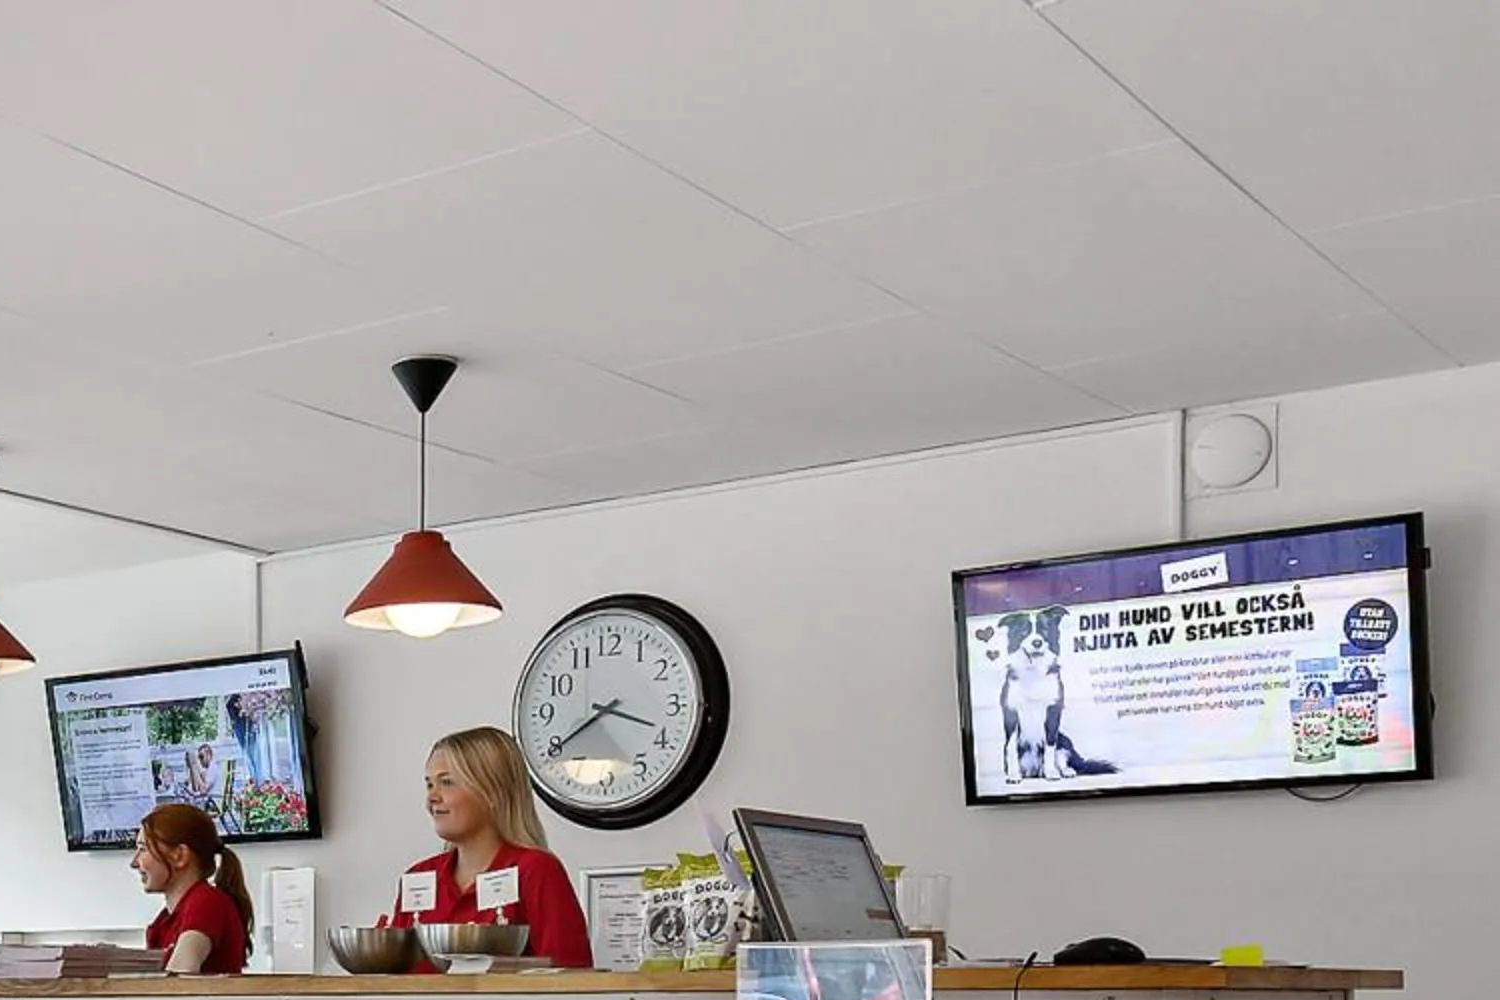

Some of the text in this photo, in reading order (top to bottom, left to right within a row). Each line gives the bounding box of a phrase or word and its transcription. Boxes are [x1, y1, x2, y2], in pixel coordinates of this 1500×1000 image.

[1170, 566, 1218, 584] DOGGY
[1079, 584, 1306, 631] DIN HUND VILL OCKSÅ
[1073, 612, 1314, 653] NJUTA AV SEMESTERN!
[598, 633, 623, 656] 12
[636, 639, 644, 662] 1
[573, 647, 590, 670] 11
[653, 659, 669, 681] 2
[550, 674, 573, 697] 10
[539, 702, 555, 726] 9
[665, 694, 681, 716] 3
[548, 735, 563, 757] 8
[653, 728, 669, 749] 4
[632, 753, 647, 777] 5
